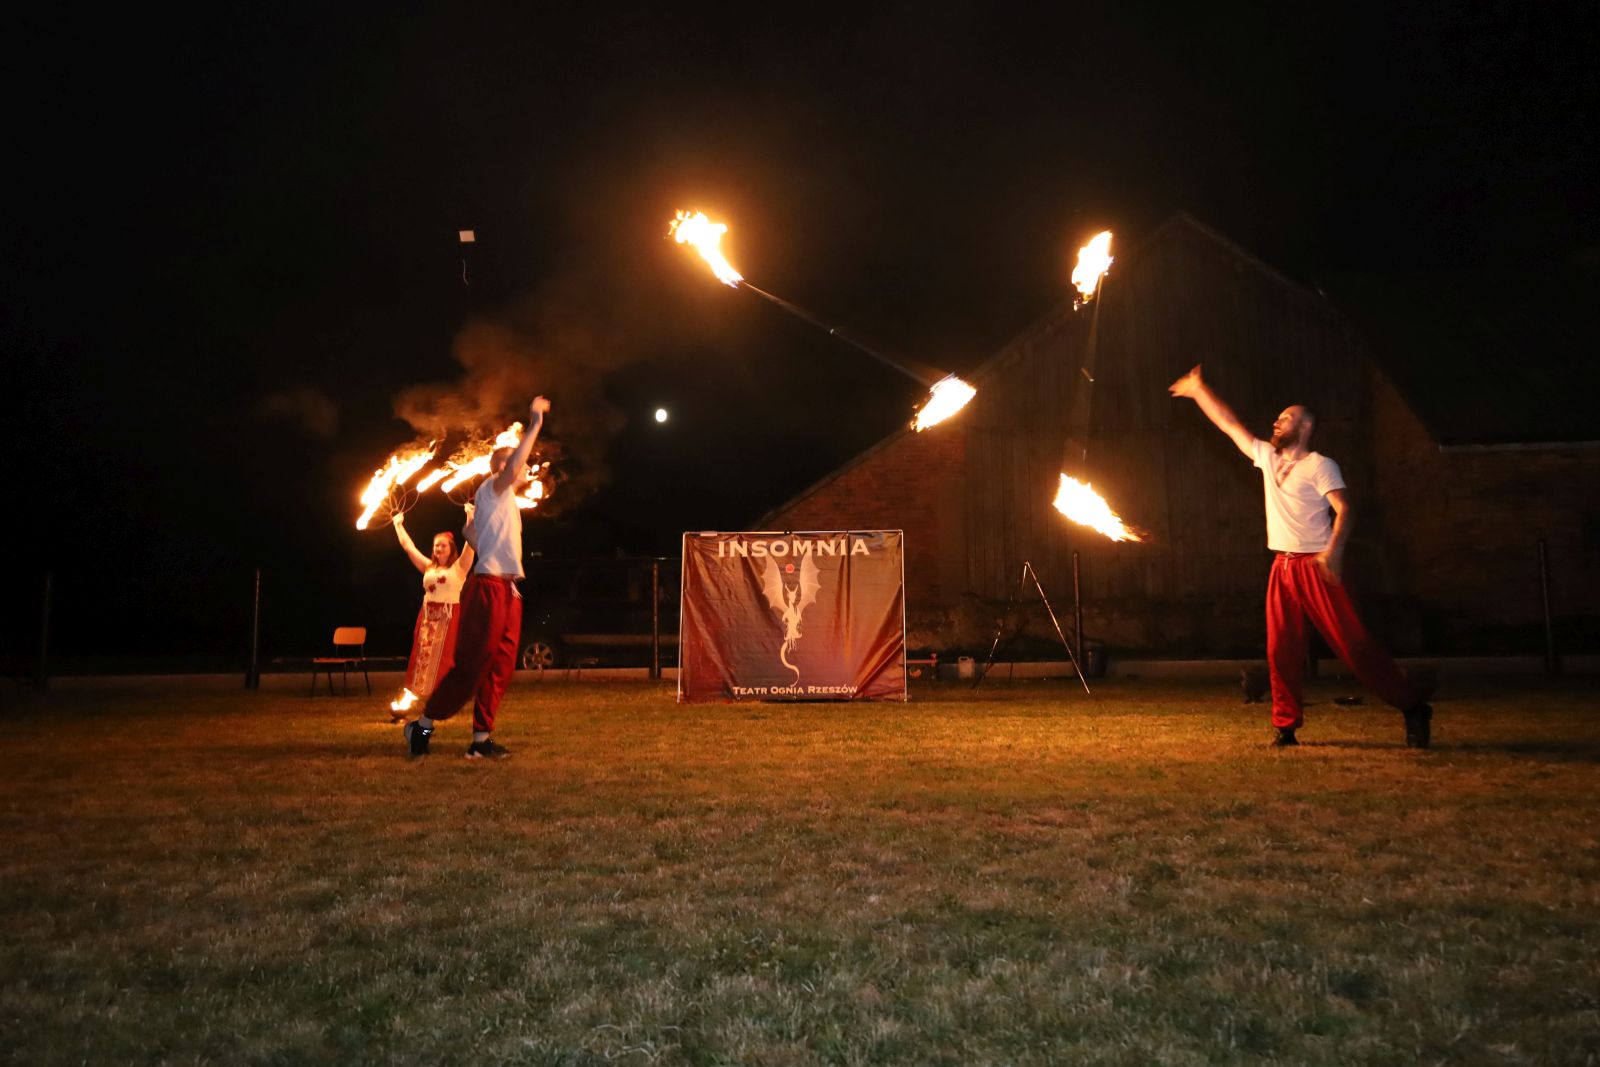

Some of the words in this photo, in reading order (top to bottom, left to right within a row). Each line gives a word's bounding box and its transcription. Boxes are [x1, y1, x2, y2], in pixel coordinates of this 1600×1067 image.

[718, 538, 871, 558] INSOMNIA
[732, 686, 768, 695] TEATR
[770, 686, 804, 695] OGNIA
